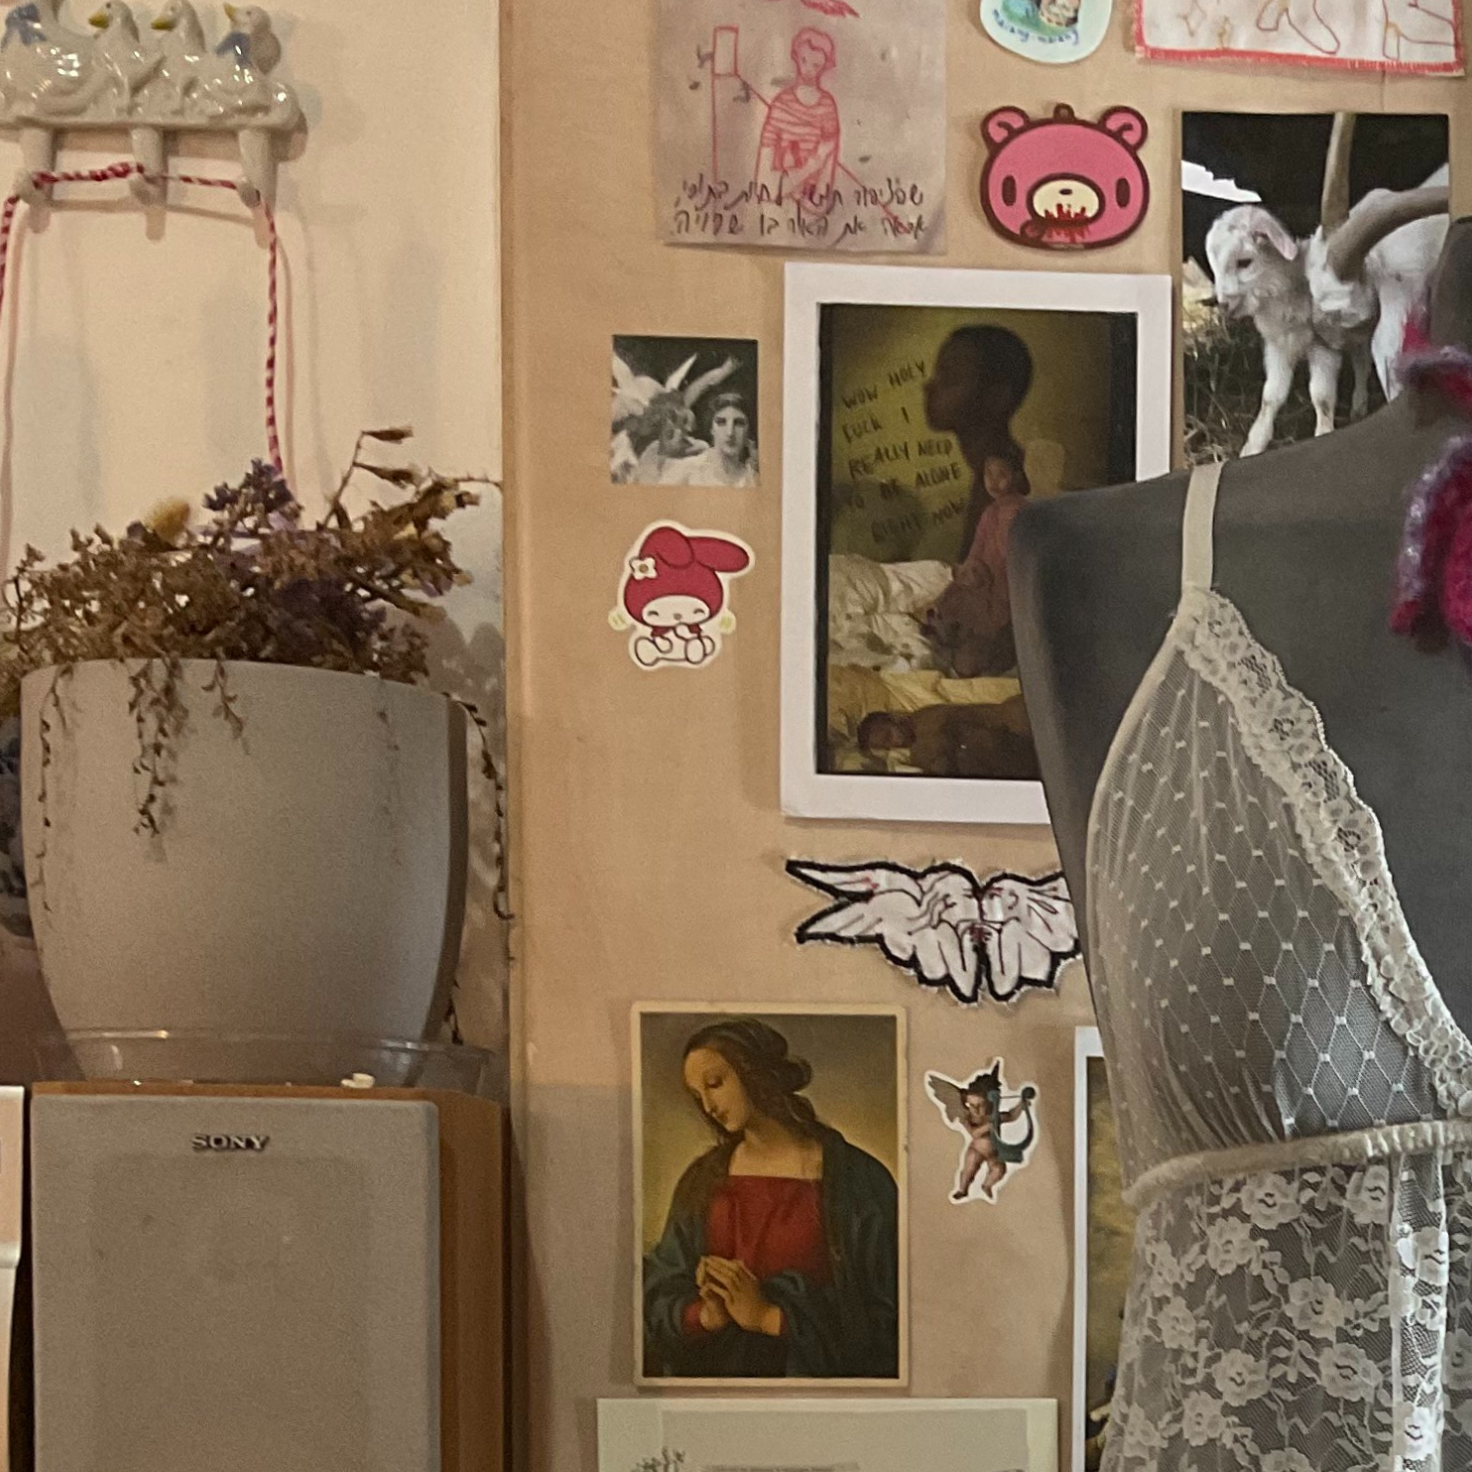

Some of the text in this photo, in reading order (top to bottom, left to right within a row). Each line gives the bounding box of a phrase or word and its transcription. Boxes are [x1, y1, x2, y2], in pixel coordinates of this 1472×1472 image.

[841, 385, 878, 409] WOW
[849, 439, 953, 480] REALLY NEED
[915, 461, 961, 488] ALONE
[191, 1134, 270, 1152] SONY
